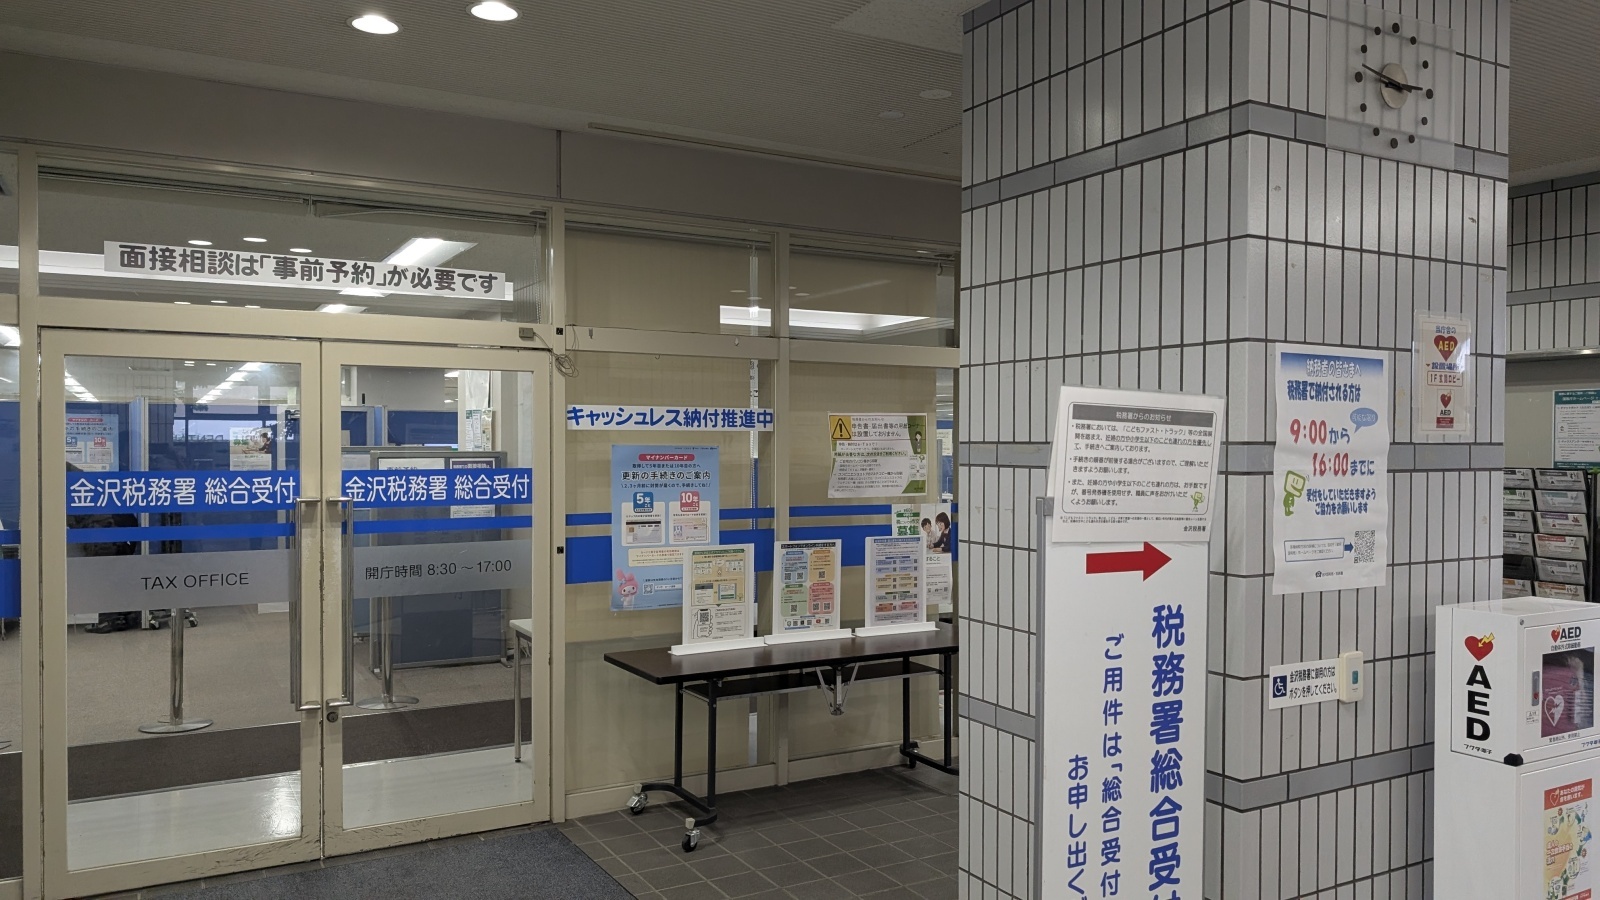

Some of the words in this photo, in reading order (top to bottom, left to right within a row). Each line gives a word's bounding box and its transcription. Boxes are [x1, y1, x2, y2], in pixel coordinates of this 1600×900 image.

[119, 243, 498, 293] 面接相談は「事前予約」が必要です
[1438, 340, 1455, 351] AED
[1306, 358, 1362, 379] 納税者の皆さまへ
[1287, 379, 1361, 403] 税務署で納付される方は
[567, 406, 774, 428] キャッシュレス納付推進中
[1115, 411, 1172, 422] 税務署からのお知らせ
[1289, 418, 1351, 445] 9:00から
[1072, 466, 1130, 475] きますようお願いします。
[1312, 452, 1375, 477] 16:00までに
[622, 471, 711, 480] 更新の手続きのご案内
[70, 476, 196, 508] 金沢税務署
[205, 475, 298, 504] 総合受付
[346, 475, 448, 502] 金沢税務署
[454, 473, 530, 500] 総合受付
[681, 492, 699, 503] 10年
[1306, 488, 1376, 502] 受付をしていただきますよう
[636, 493, 651, 504] 5年
[1070, 499, 1118, 507] くようお願いします。
[1315, 502, 1368, 516] ご協力をお願いします
[896, 525, 920, 536] 募集
[365, 564, 423, 580] 開庁時間
[427, 562, 457, 577] 8:30
[476, 559, 512, 574] 17:00
[141, 575, 178, 591] TAX
[184, 571, 250, 589] OFFICE
[1560, 626, 1582, 641] AED
[1288, 682, 1337, 700] ボタンを押してください。
[1466, 664, 1492, 741] AED
[1148, 604, 1186, 900] 税務署総合受
[1100, 633, 1125, 898] ご用件は「総合受付
[1067, 754, 1089, 900] お申し出く
